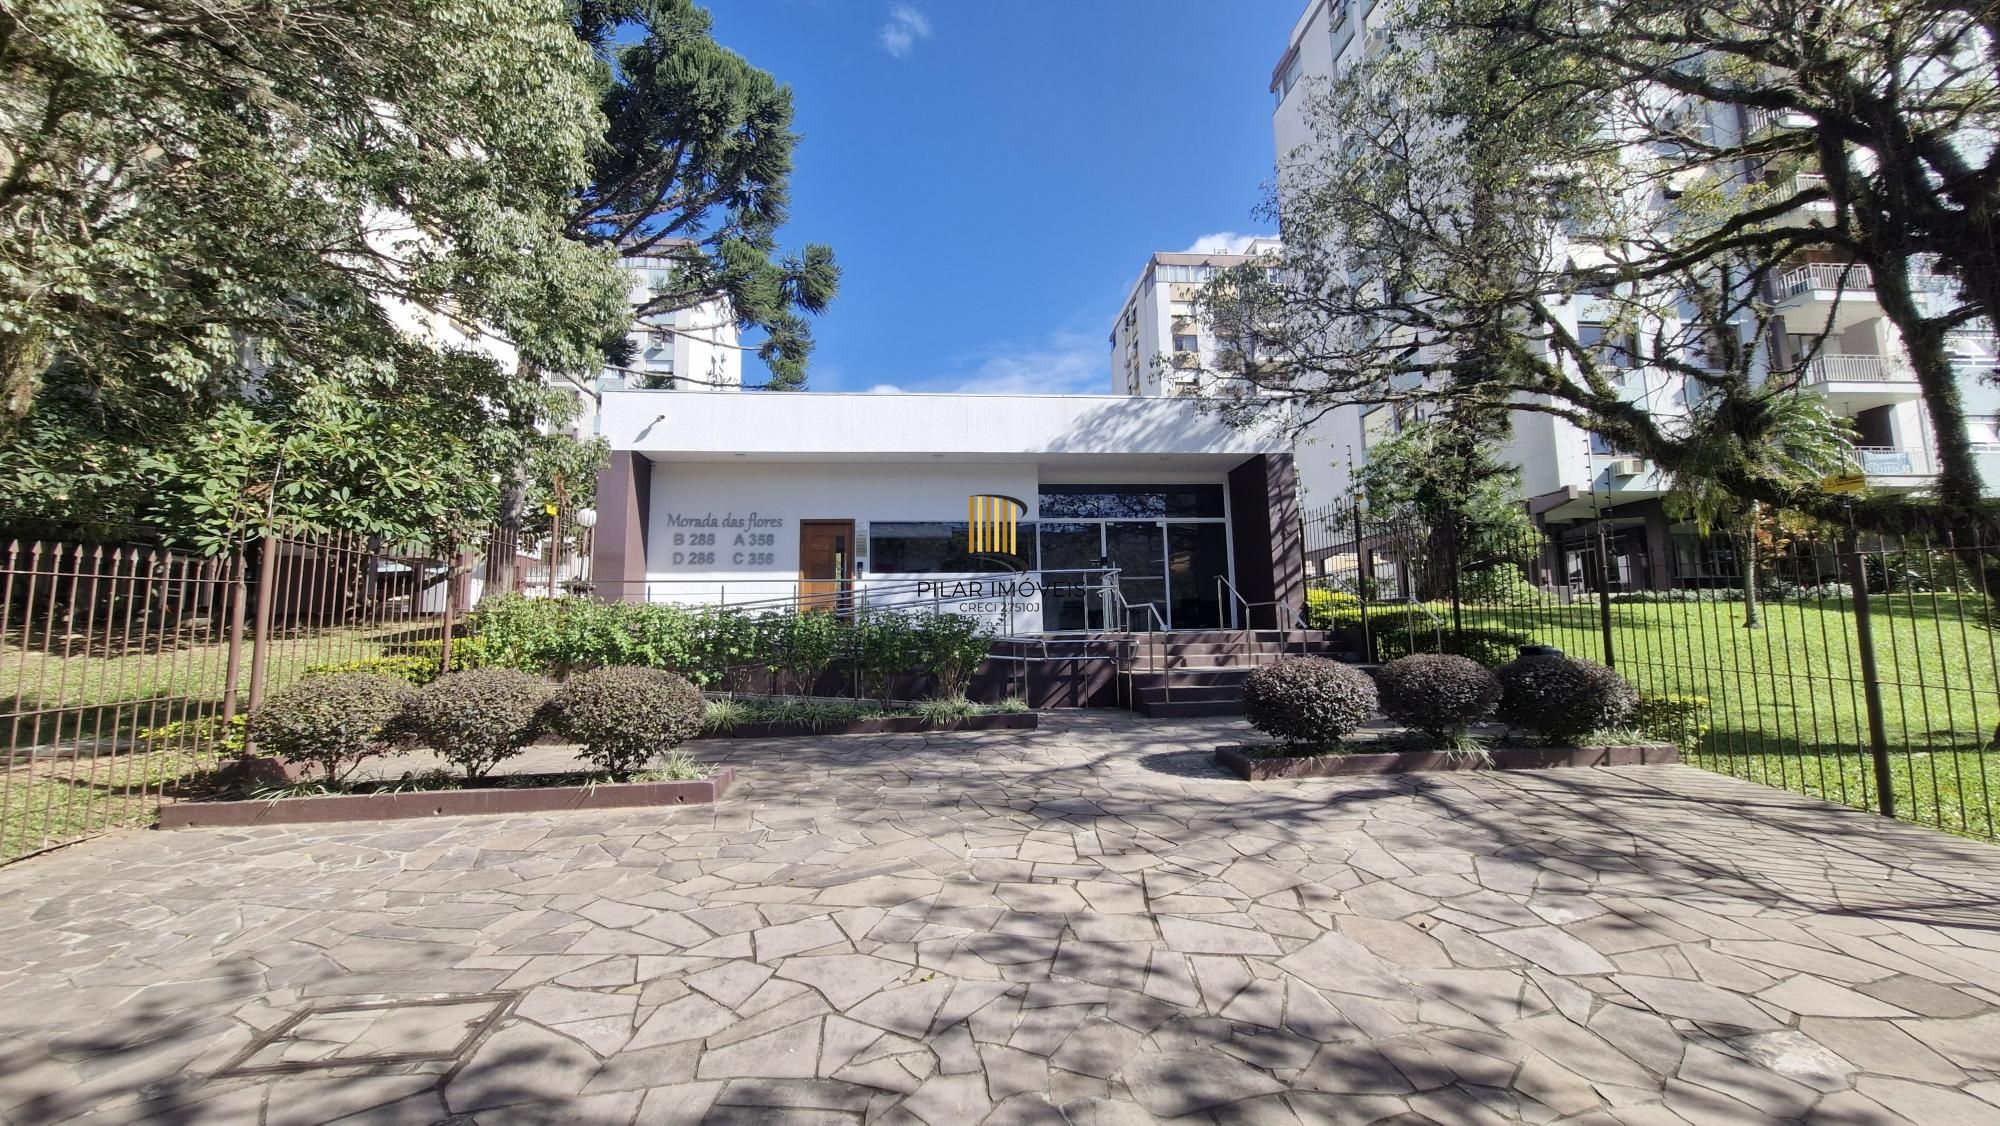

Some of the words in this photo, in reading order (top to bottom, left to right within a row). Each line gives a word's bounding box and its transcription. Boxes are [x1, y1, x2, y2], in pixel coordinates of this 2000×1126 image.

[666, 512, 718, 528] Morada
[722, 512, 745, 528] das
[744, 512, 783, 532] flores
[673, 533, 685, 546] B
[733, 533, 745, 546] A
[673, 552, 685, 565] D
[688, 552, 715, 565] 286
[732, 552, 744, 565] C
